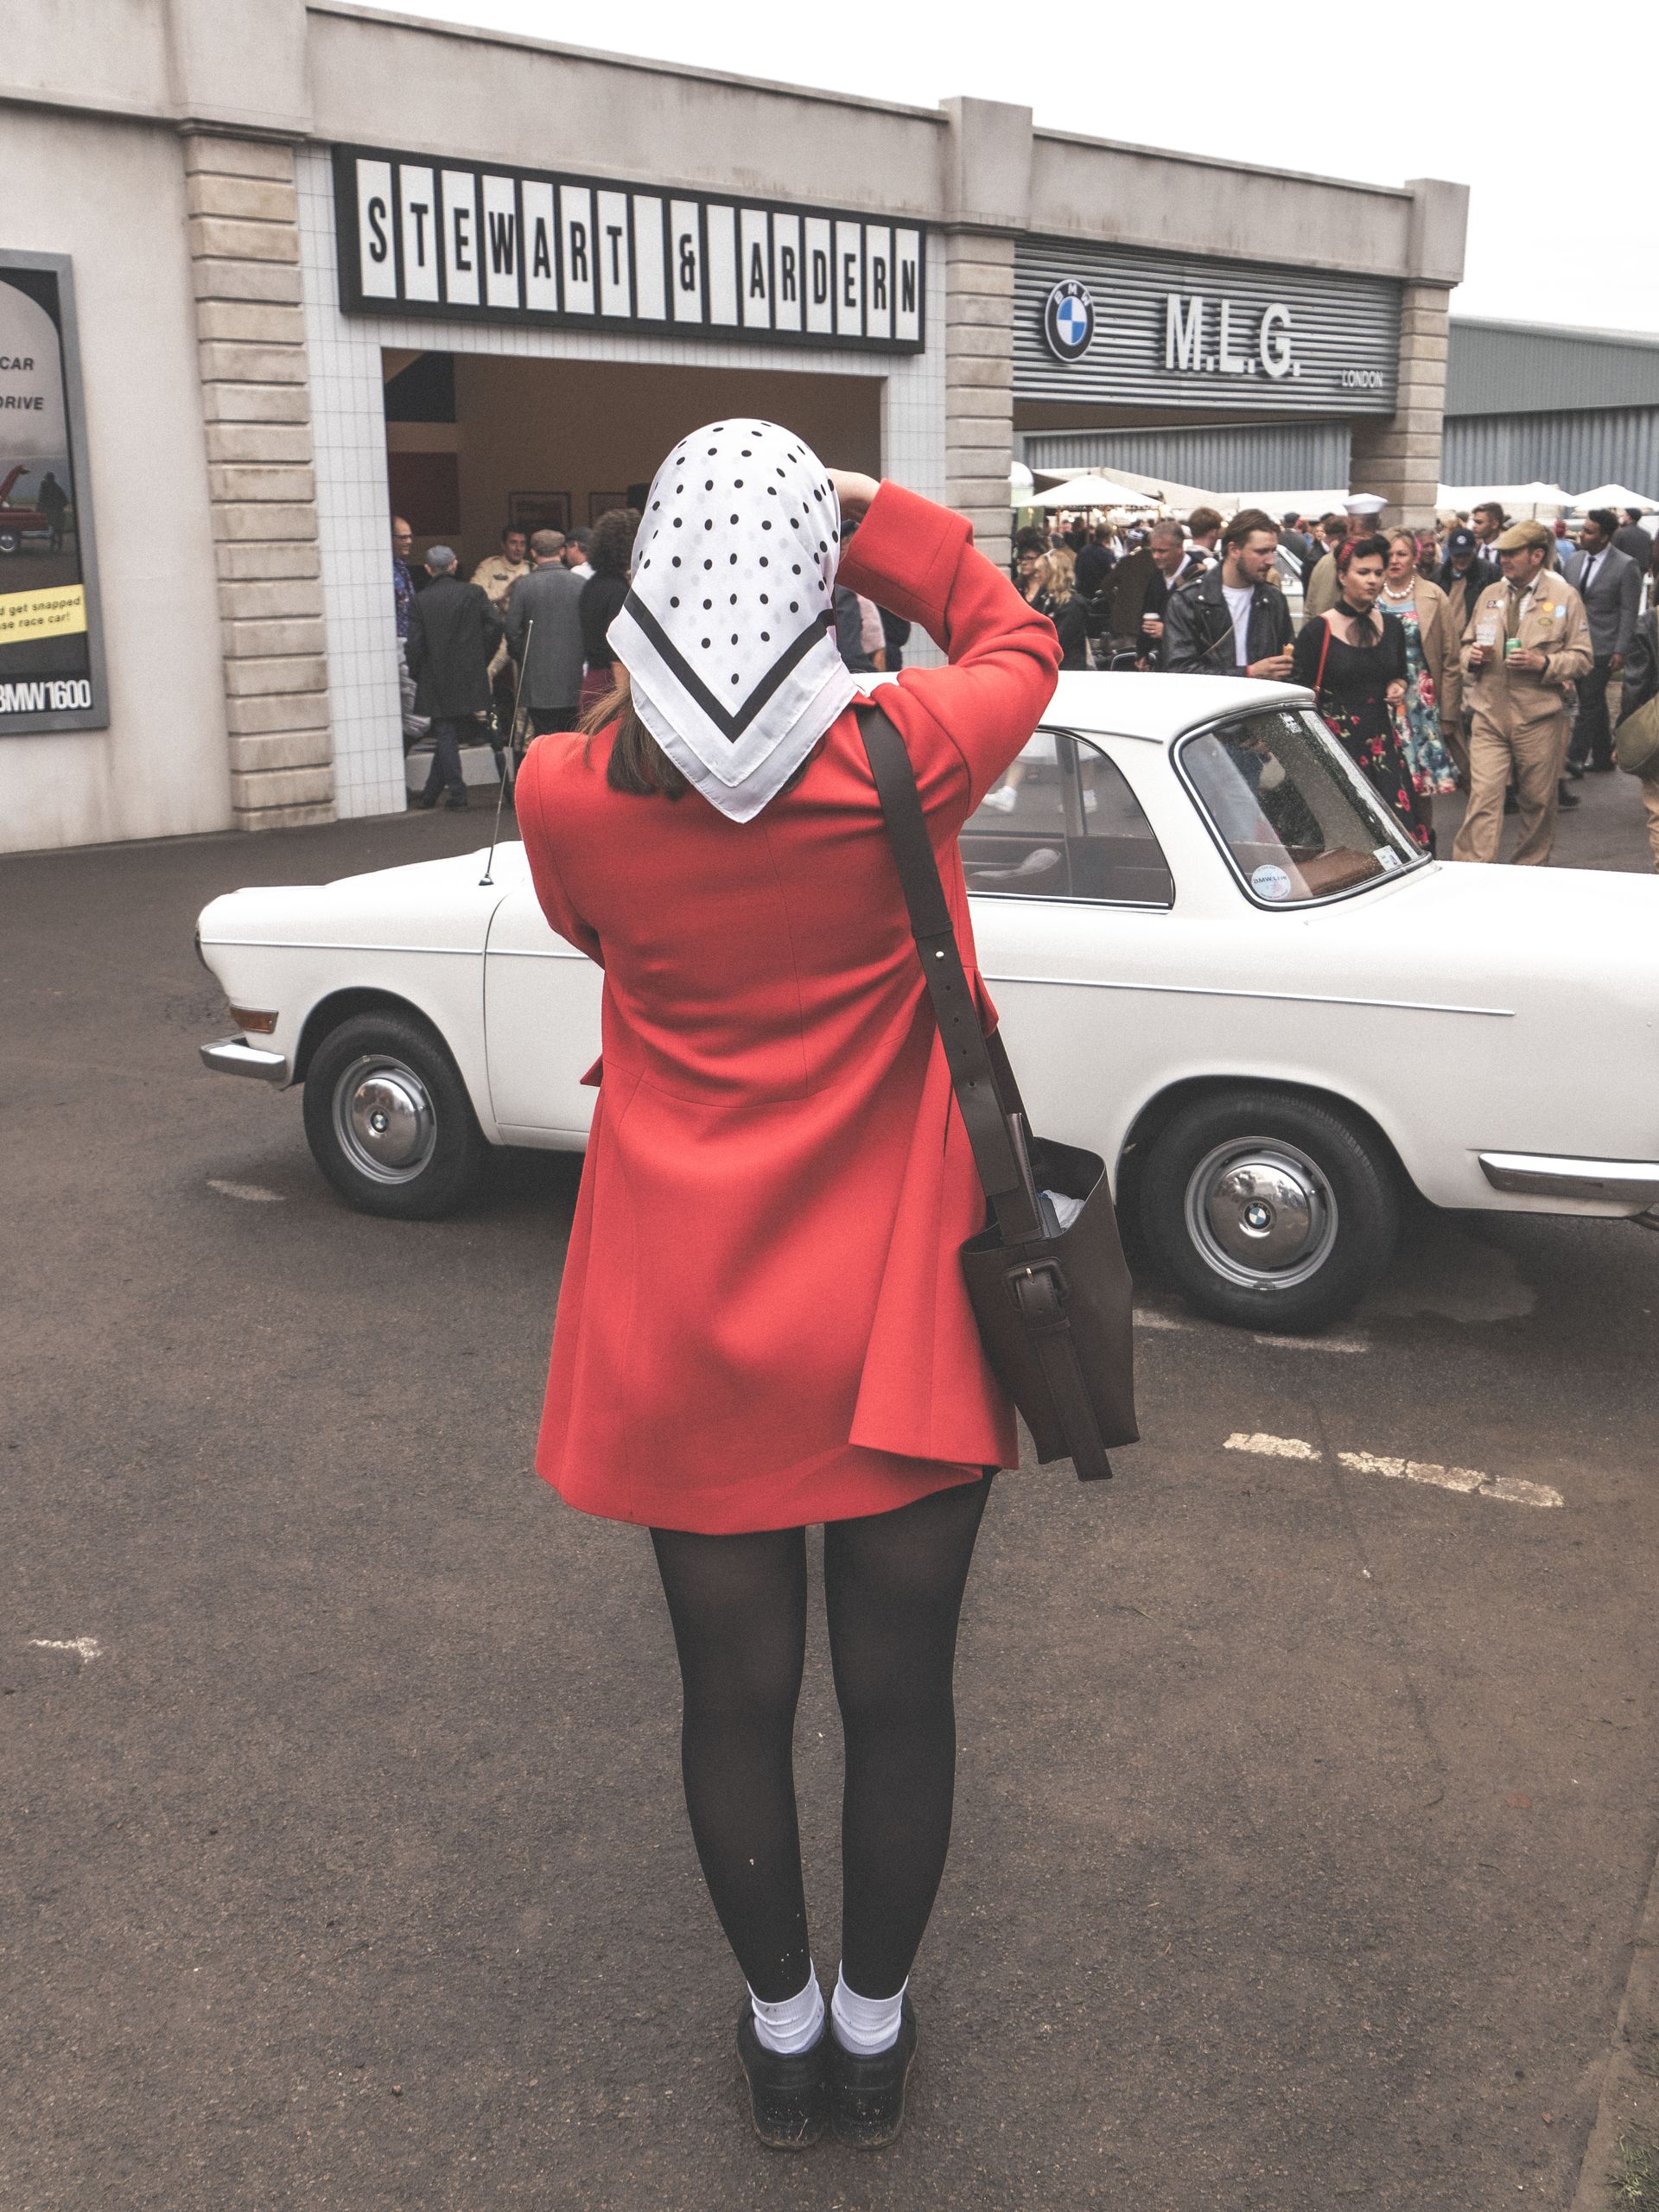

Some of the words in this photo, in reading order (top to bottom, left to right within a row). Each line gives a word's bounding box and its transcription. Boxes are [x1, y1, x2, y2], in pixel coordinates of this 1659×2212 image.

[367, 195, 623, 286] STEWART
[678, 232, 696, 292] &
[749, 241, 915, 314] ARDERN
[1053, 283, 1091, 307] BMW
[1166, 292, 1301, 378] M.L.G.
[0, 355, 35, 371] CAR
[1341, 369, 1383, 388] LONDON
[32, 595, 80, 611] snapped
